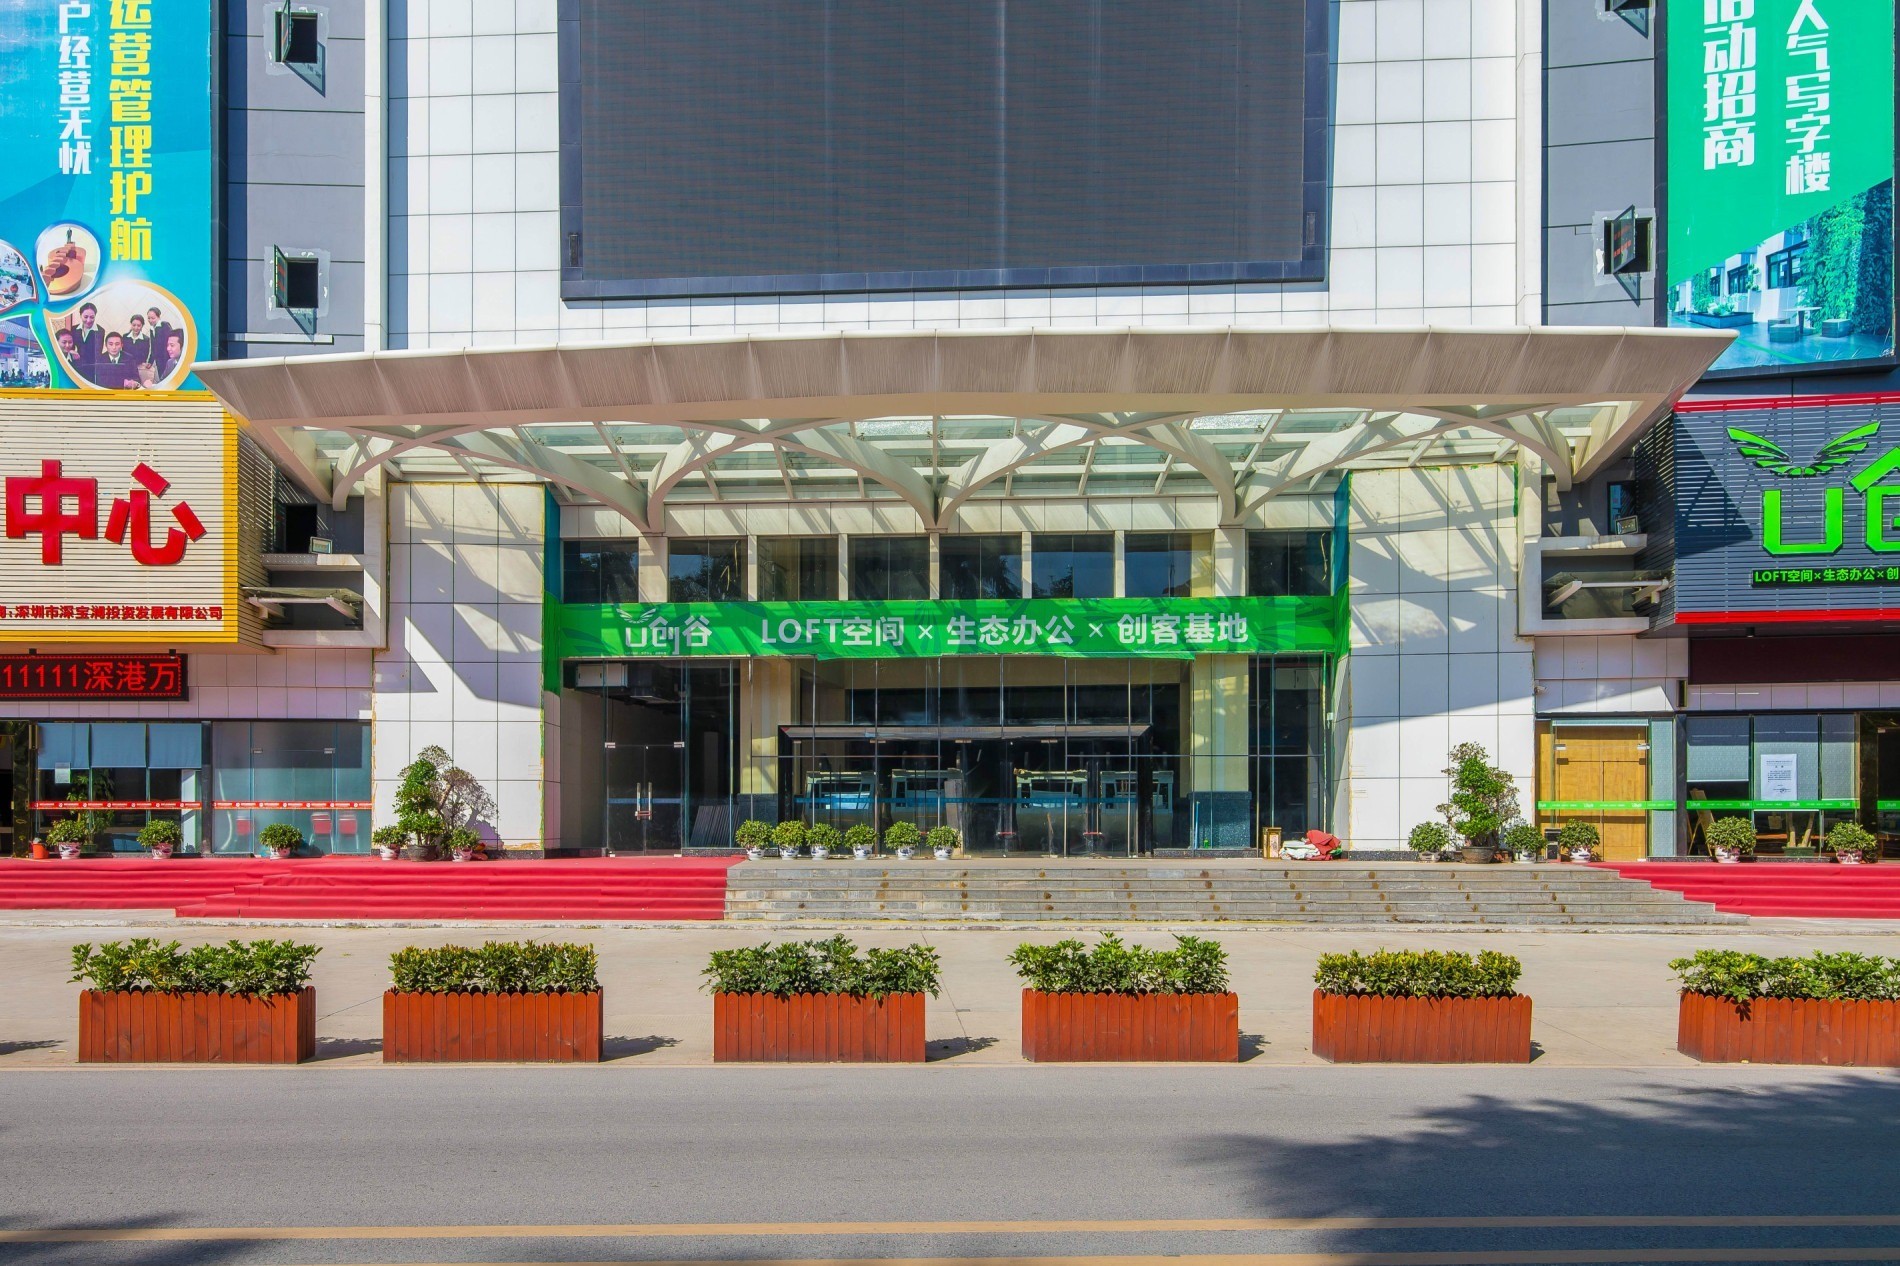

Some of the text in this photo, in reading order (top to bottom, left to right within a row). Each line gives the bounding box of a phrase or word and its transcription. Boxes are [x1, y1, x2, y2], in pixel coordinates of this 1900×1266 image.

[58, 0, 92, 175] 户经营无忧
[109, 0, 152, 261] 运营管理护航
[5, 459, 206, 566] 中心
[762, 616, 904, 647] LOFT空间
[946, 615, 1075, 646] 生态办公
[1117, 613, 1248, 645] 创客基地
